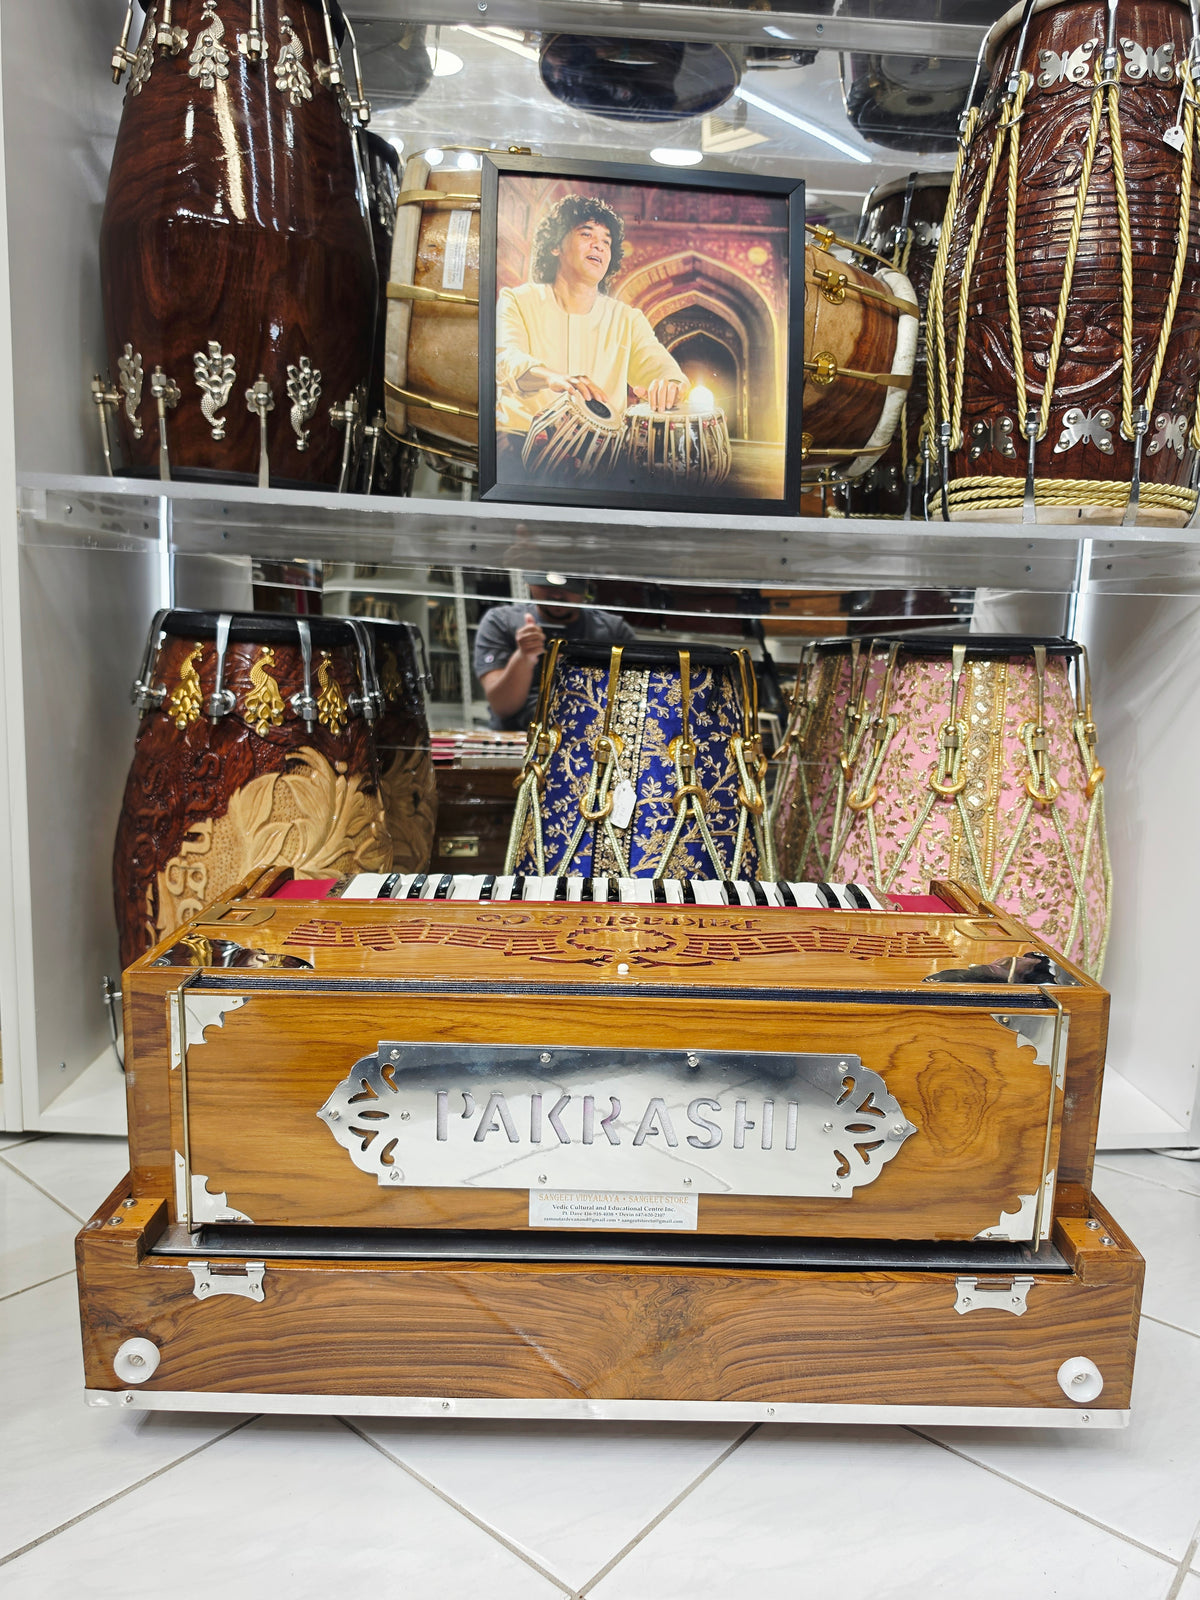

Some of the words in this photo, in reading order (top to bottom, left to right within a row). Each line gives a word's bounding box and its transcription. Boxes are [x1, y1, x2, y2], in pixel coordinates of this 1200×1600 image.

[577, 914, 762, 932] Pakrashi
[435, 1090, 799, 1151] PAKRASHI
[538, 1193, 573, 1201] SANGEET
[575, 1193, 620, 1202] VIDYALAYA
[628, 1195, 664, 1203] SANGEET
[665, 1196, 689, 1204] STORE
